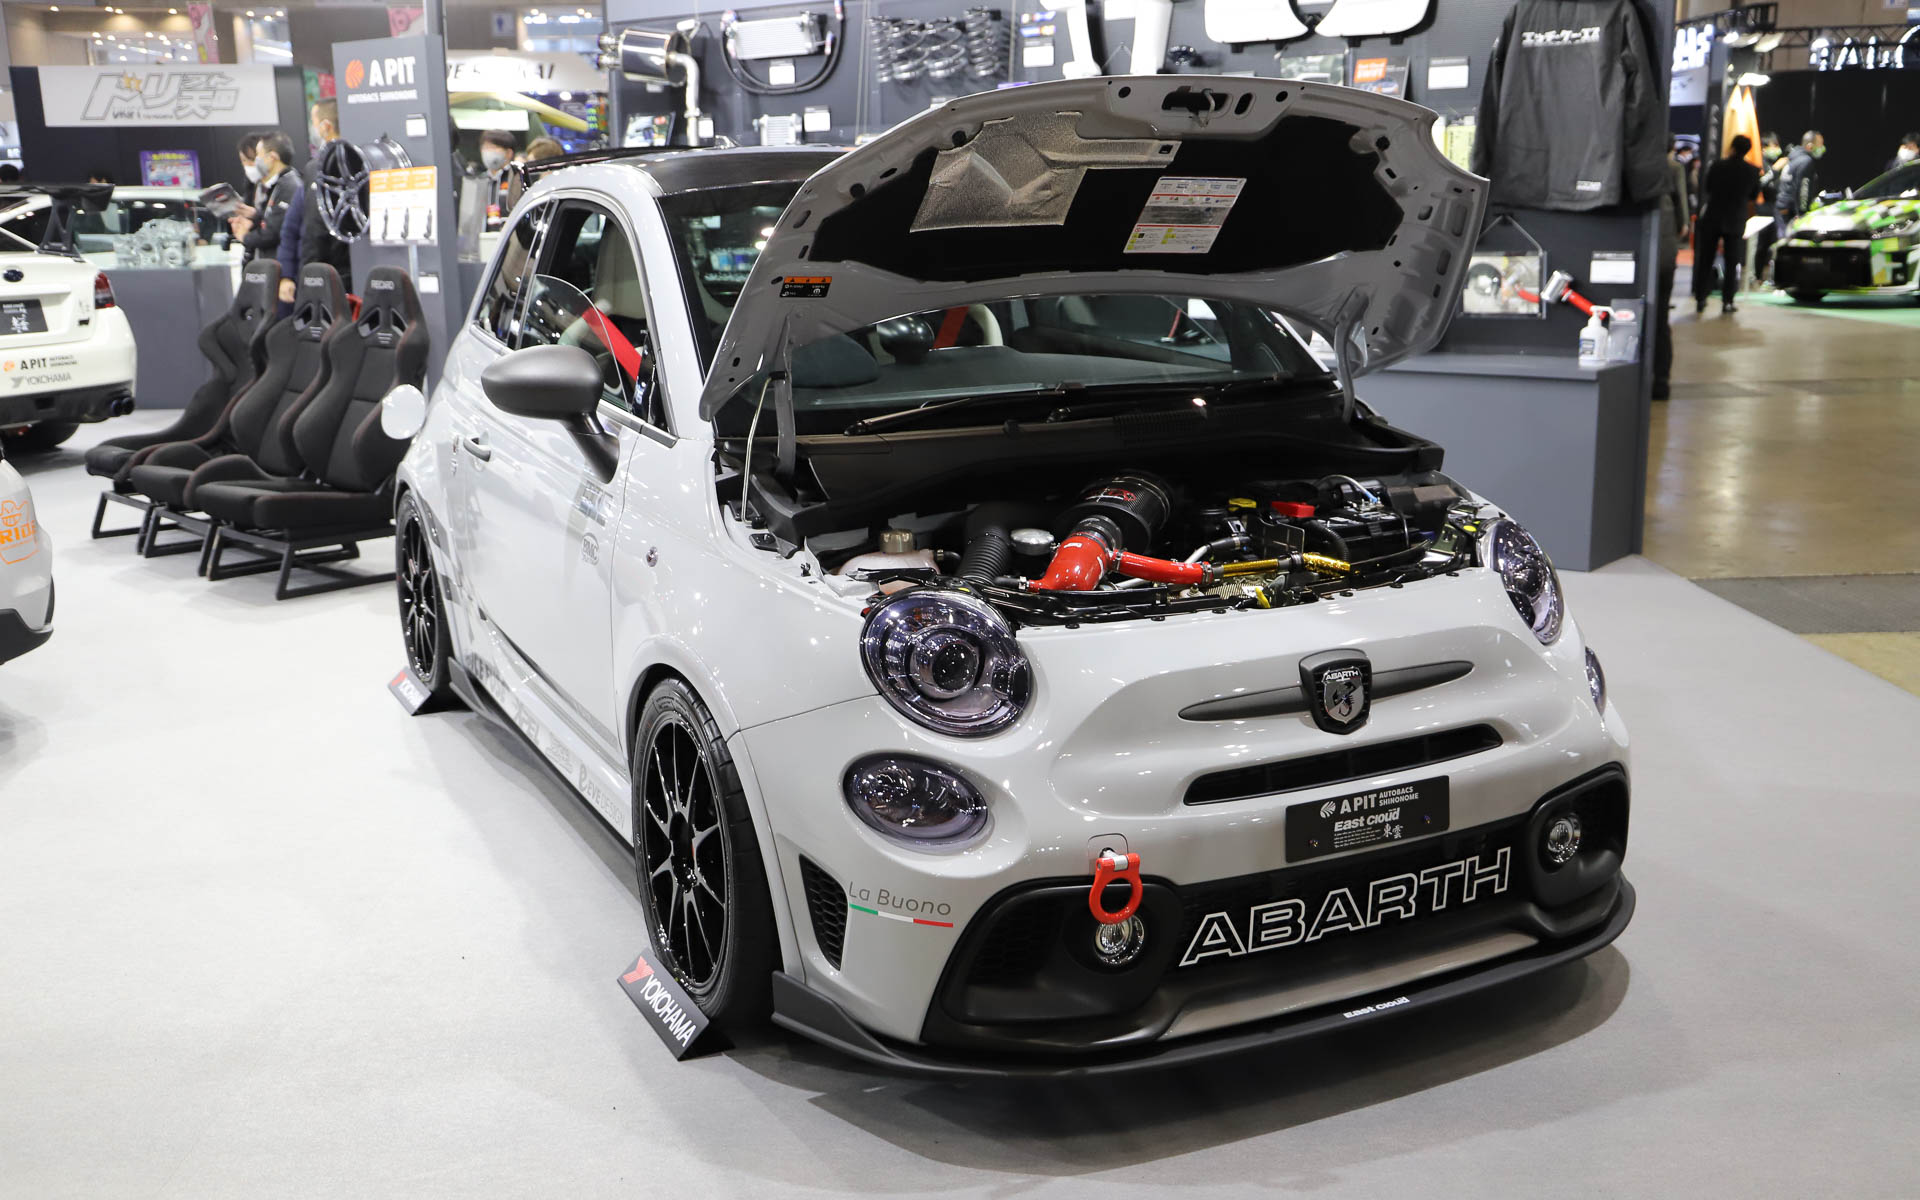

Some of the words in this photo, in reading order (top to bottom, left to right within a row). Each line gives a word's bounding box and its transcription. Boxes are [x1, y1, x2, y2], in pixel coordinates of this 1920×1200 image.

[1325, 670, 1360, 681] ABARTH
[1379, 786, 1414, 799] AUTOBACS
[1379, 792, 1419, 807] SHINONOME
[1334, 818, 1365, 833] East
[848, 881, 871, 902] La
[877, 888, 952, 916] Buono
[1178, 846, 1511, 967] ABARTH
[640, 973, 697, 1048] YOKOHAMA
